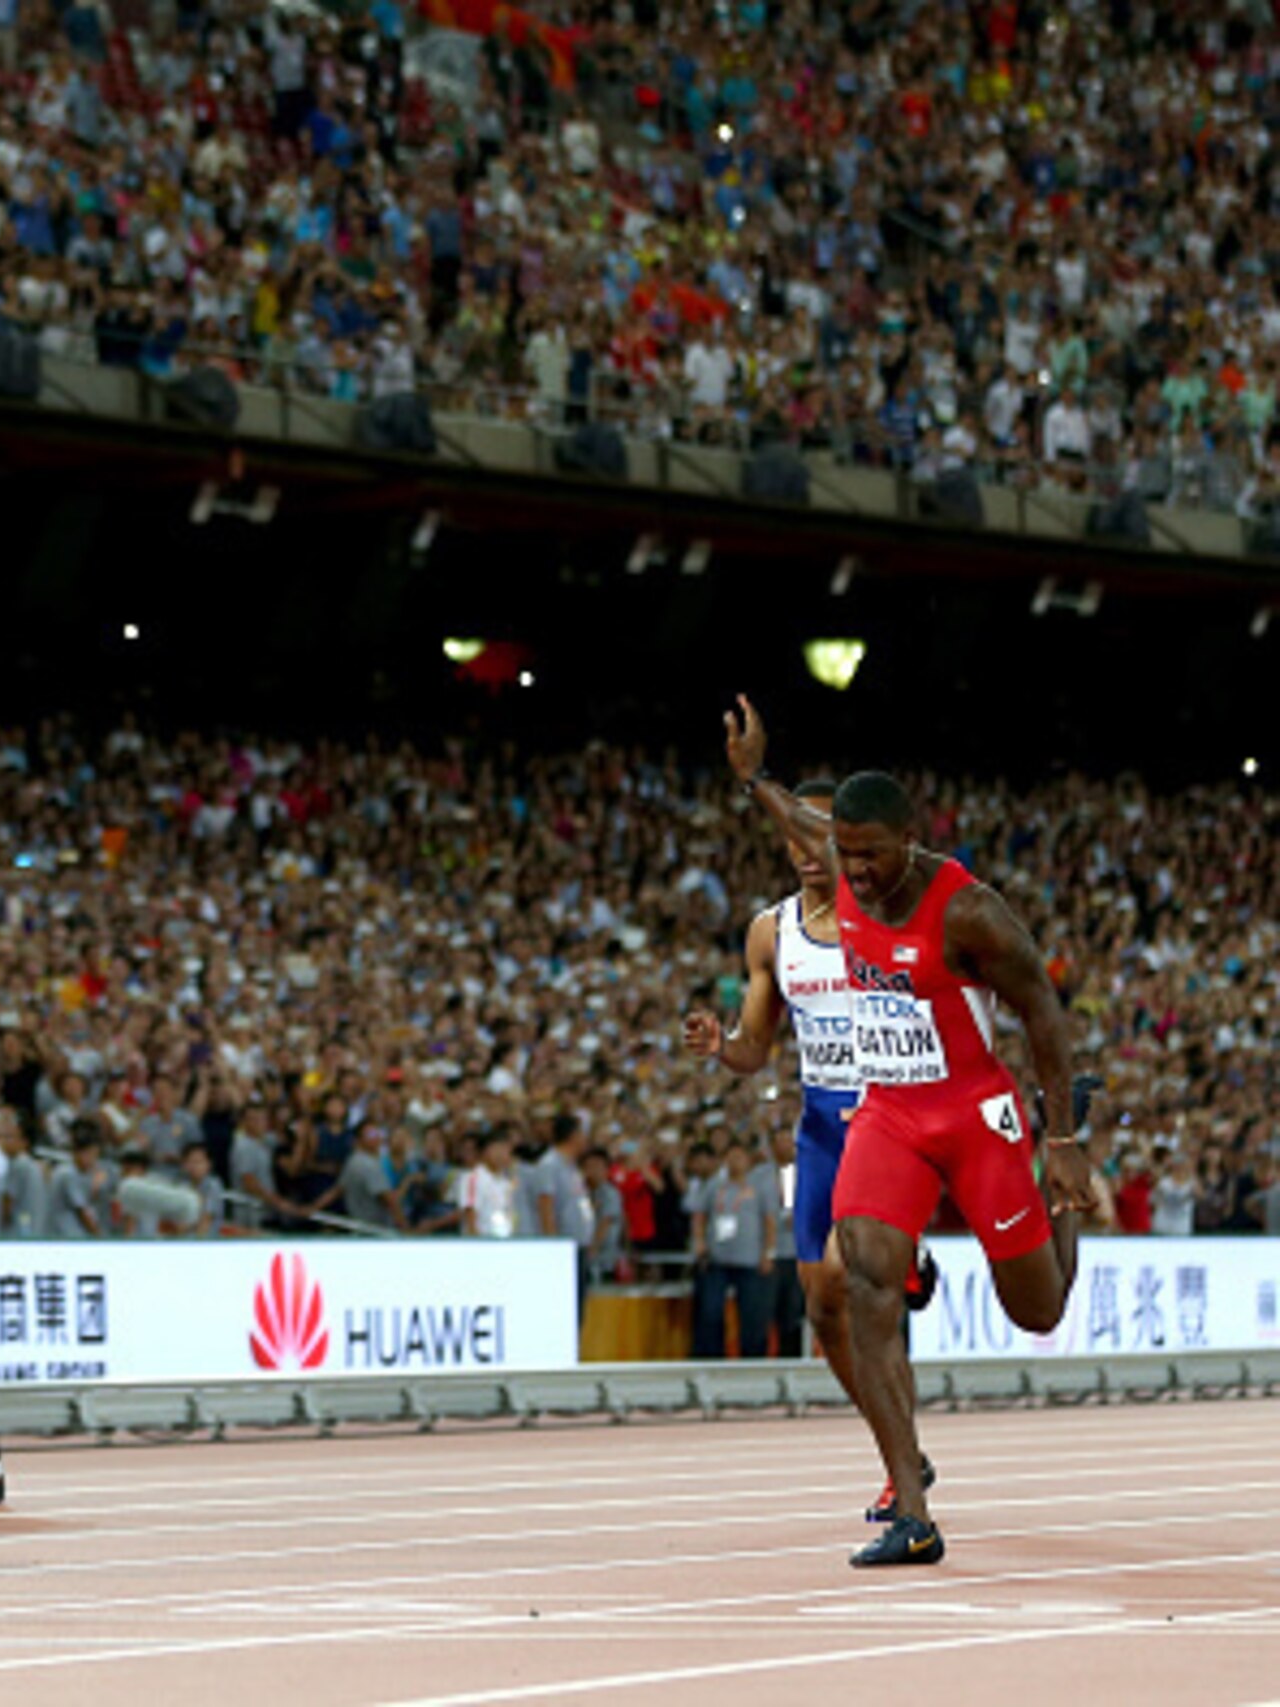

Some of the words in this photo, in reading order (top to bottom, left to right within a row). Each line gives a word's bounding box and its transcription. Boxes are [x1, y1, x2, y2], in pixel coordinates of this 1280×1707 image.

[866, 995, 923, 1018] TDK
[999, 1102, 1018, 1135] 4
[344, 1304, 506, 1368] HUAWEI
